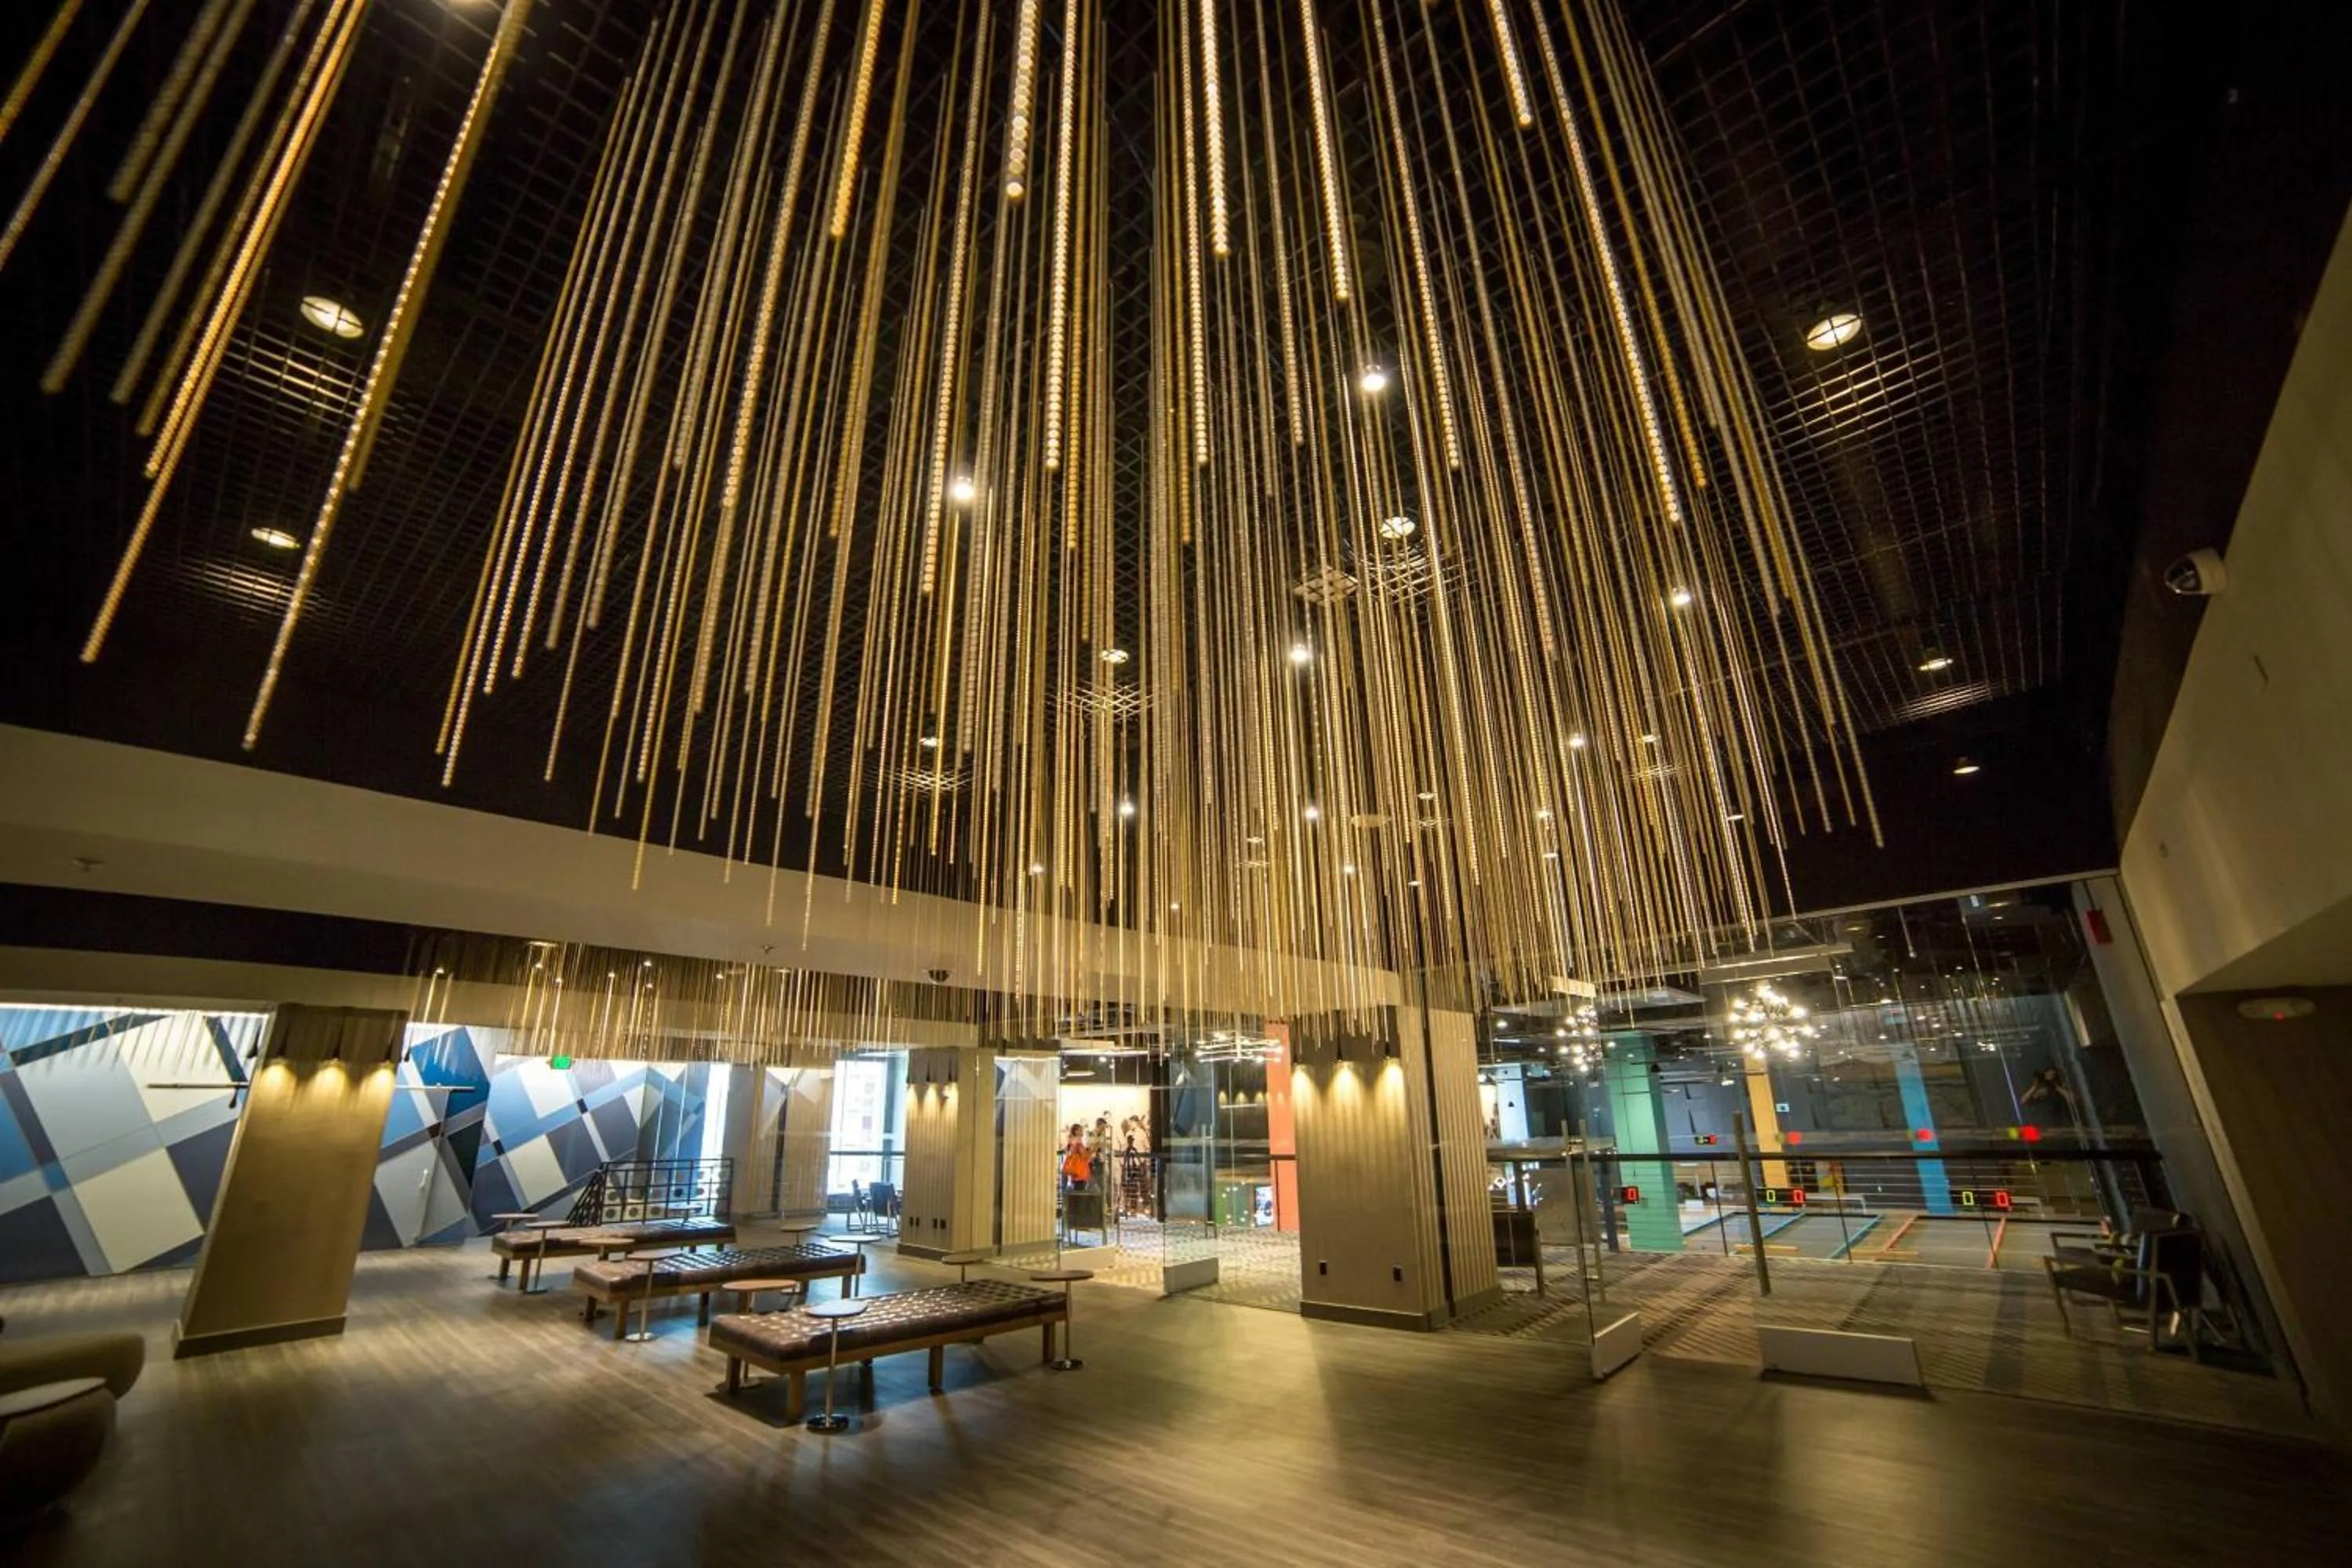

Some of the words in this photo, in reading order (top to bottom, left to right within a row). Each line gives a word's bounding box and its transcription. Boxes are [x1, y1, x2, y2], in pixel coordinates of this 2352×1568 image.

[1628, 1188, 1636, 1200] 0
[1766, 1189, 1776, 1202] 0
[1793, 1189, 1803, 1203] 0
[1962, 1191, 1974, 1205] 0
[1996, 1192, 2009, 1207] 0
